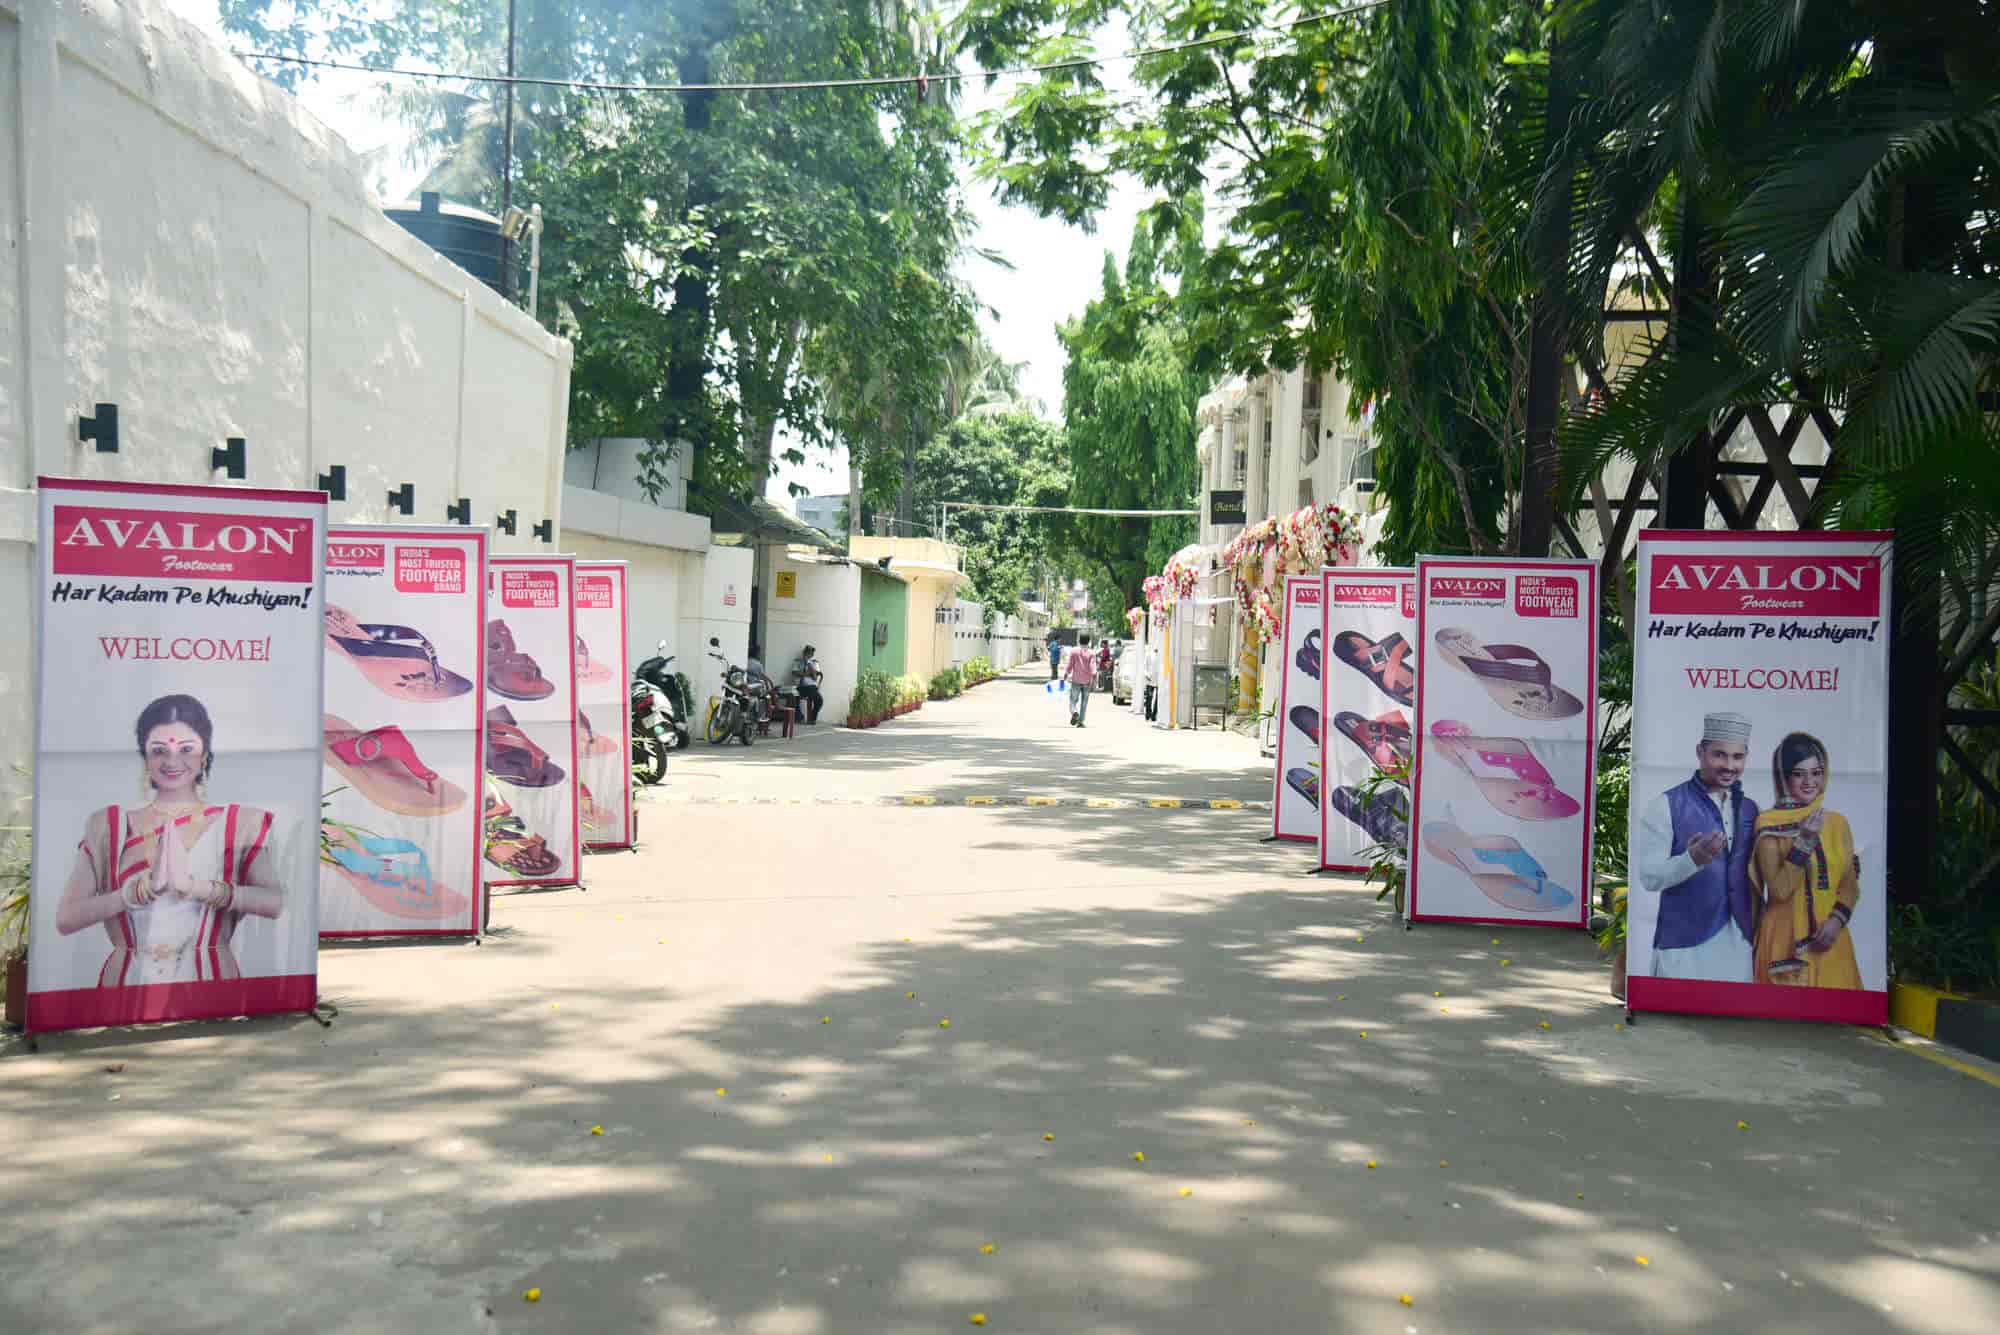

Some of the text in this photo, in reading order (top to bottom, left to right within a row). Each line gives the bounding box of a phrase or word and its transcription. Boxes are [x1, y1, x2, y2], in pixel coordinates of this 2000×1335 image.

[61, 517, 299, 555] AVALON
[327, 545, 380, 559] ALON
[161, 555, 234, 573] Footwear
[400, 559, 461, 569] MOST TRUSTED
[400, 569, 461, 583] FOOTWEAR
[1656, 564, 1867, 592] AVALON
[1336, 586, 1394, 597] AVALON
[1432, 580, 1503, 591] AVALON
[1520, 586, 1574, 596] MOST TRUSTED
[52, 581, 313, 611] Har Kadam Pe Khushiyan!
[506, 589, 554, 601] FOOTWEAR
[1297, 590, 1320, 598] AVA
[1520, 596, 1574, 608] FOOTWEAR
[1739, 594, 1805, 611] Footwear
[1550, 607, 1575, 617] BRAND
[1648, 619, 1880, 643] Har Kadam Pe Khushiyan!
[98, 635, 272, 662] WELCOME!
[1683, 668, 1839, 691] WELCOME!
